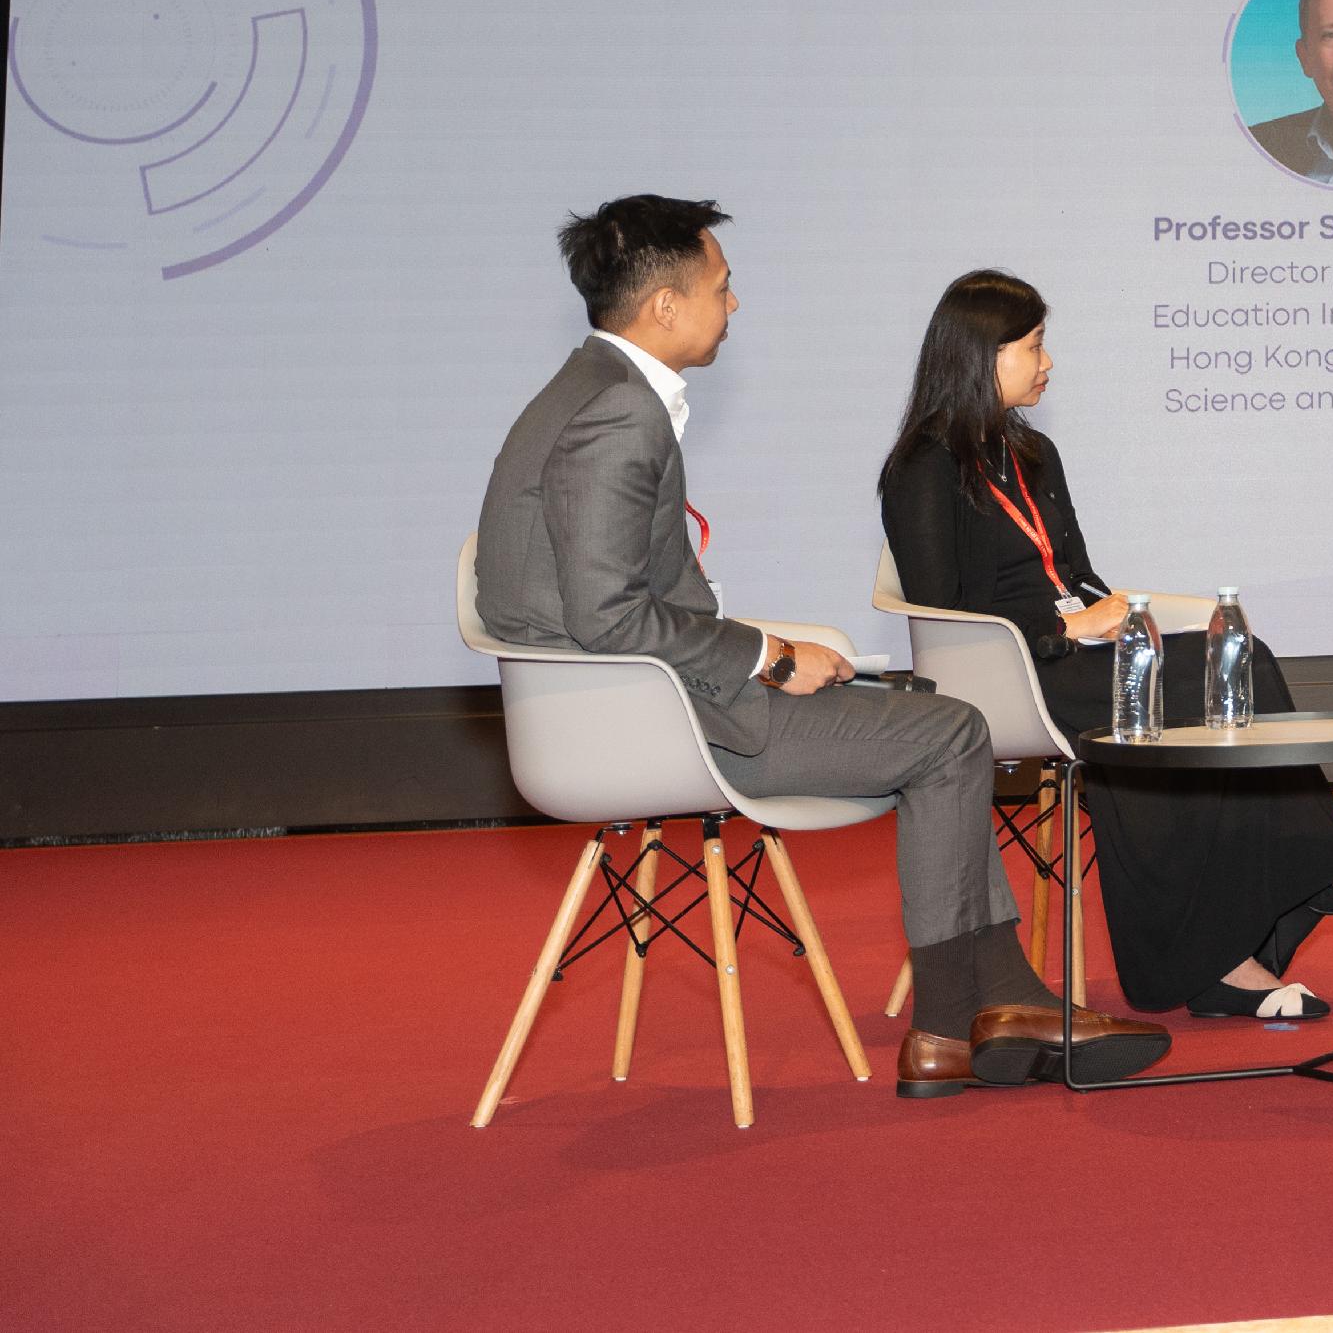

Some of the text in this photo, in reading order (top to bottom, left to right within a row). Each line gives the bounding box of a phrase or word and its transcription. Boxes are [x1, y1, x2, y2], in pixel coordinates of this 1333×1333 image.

[1154, 215, 1310, 241] Professor
[1154, 302, 1309, 328] Education
[1171, 347, 1252, 375] Hong
[1165, 388, 1286, 413] Science
